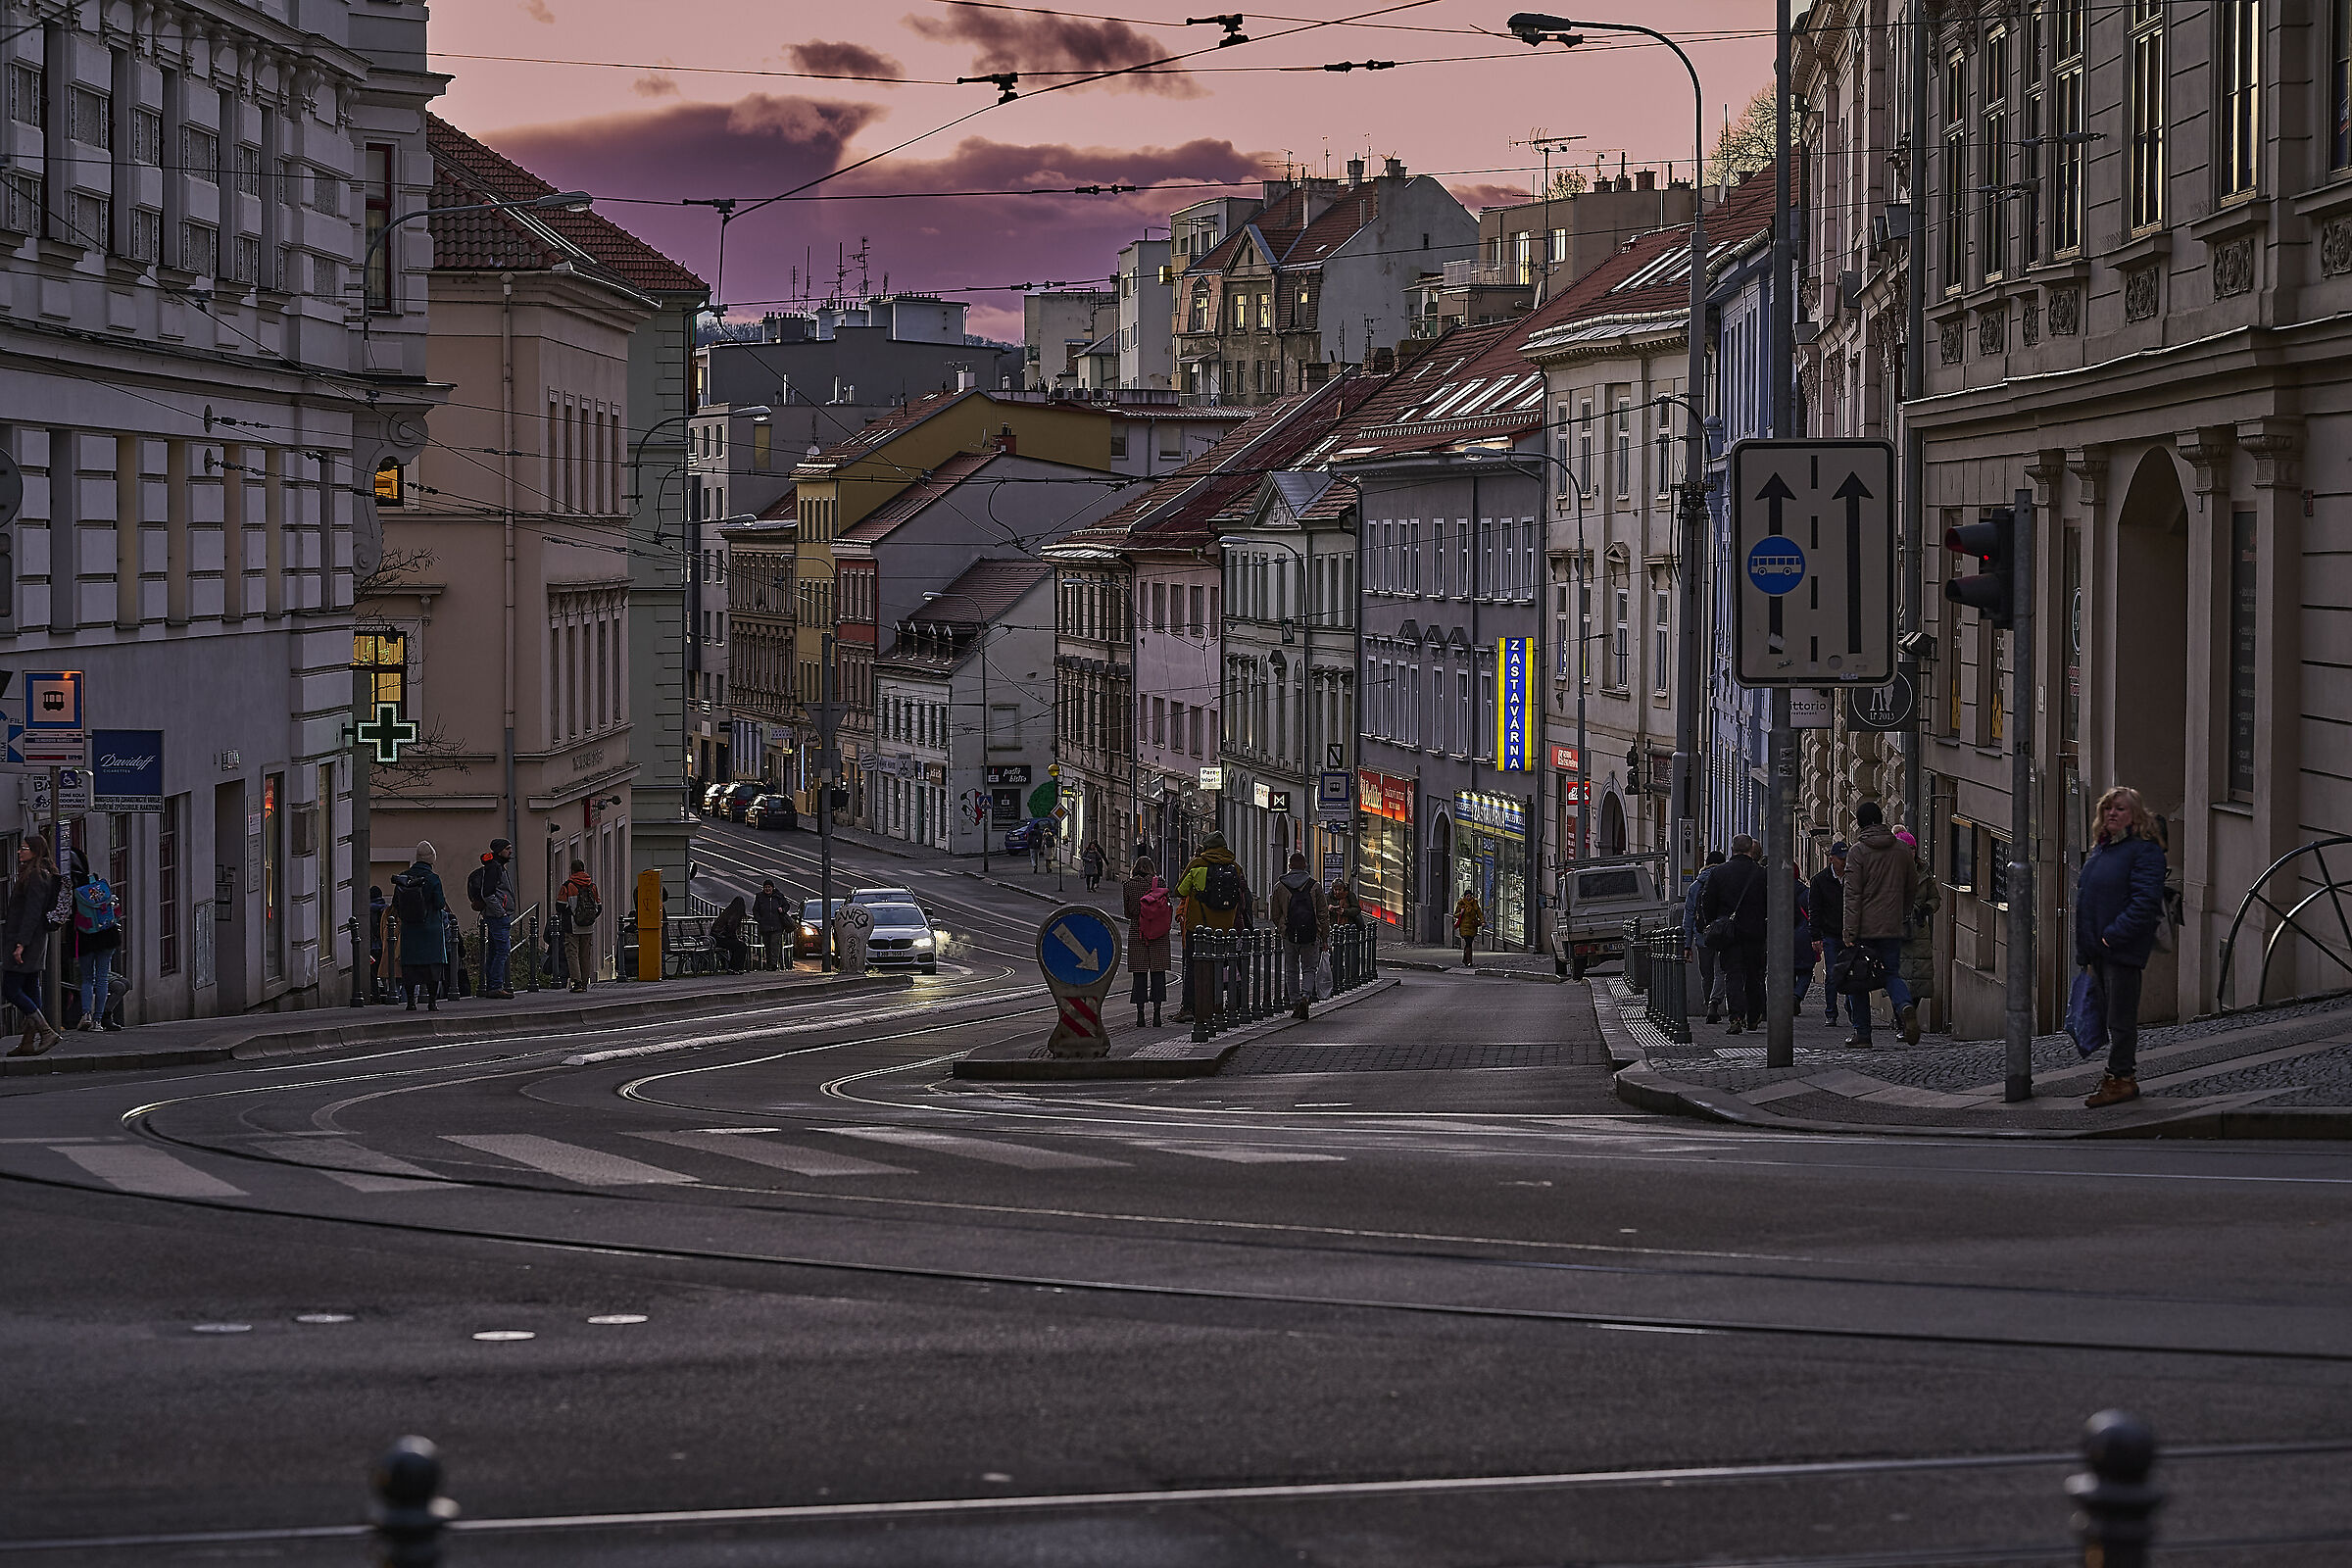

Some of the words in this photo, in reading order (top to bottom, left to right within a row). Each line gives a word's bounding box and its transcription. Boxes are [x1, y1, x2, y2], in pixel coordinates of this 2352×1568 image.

[1509, 639, 1521, 769] ZASTAVÁRNA
[1789, 701, 1827, 710] ittorio
[1880, 711, 1895, 721] 2013
[100, 753, 156, 771] Davidoff
[1004, 767, 1021, 777] pasta
